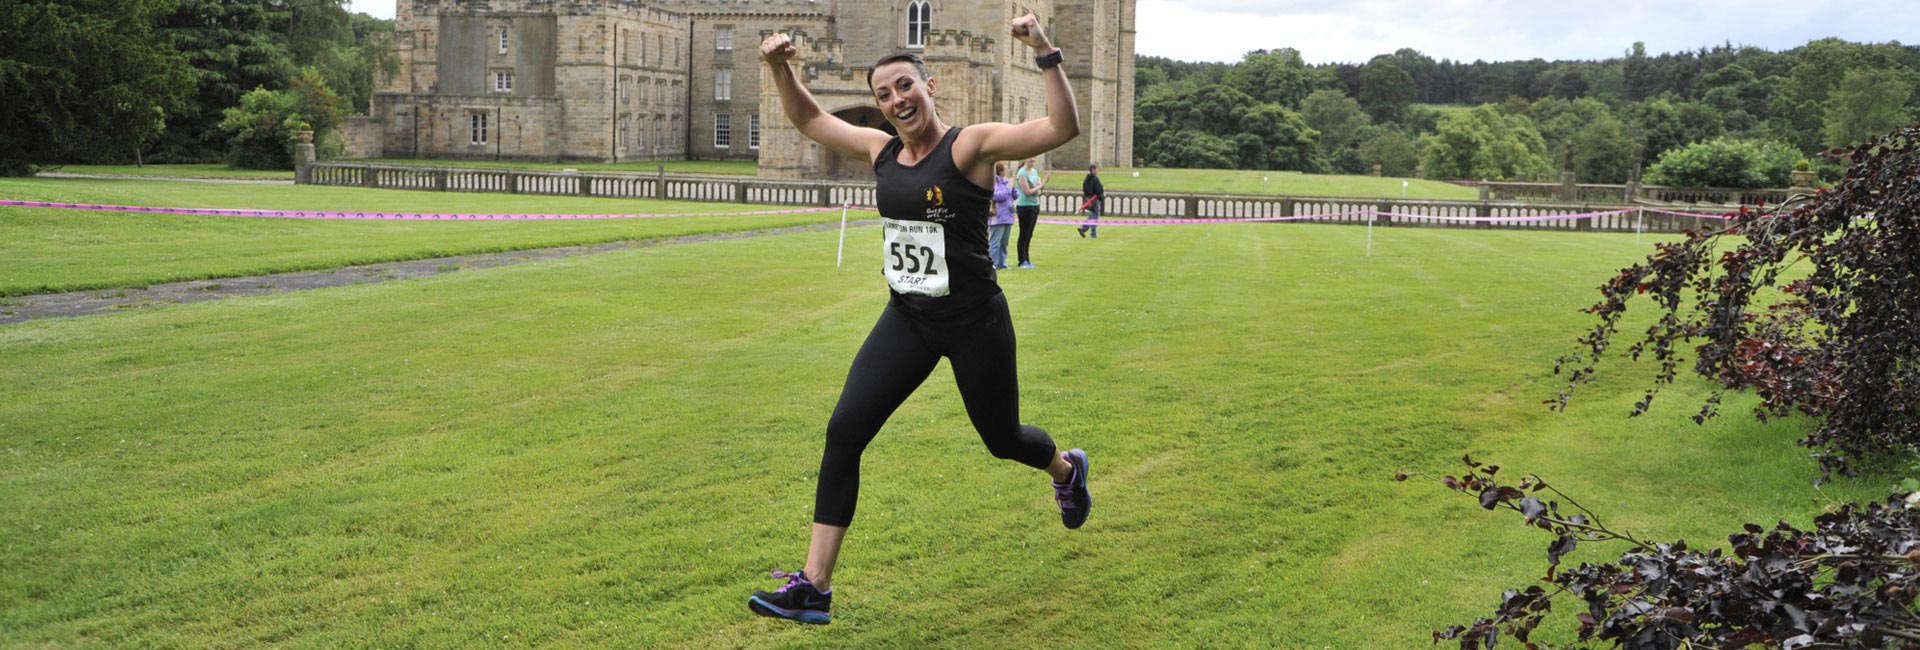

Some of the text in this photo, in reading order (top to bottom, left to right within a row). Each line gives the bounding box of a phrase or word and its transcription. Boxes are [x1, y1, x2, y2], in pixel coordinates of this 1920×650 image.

[909, 225, 924, 234] RUN
[925, 226, 938, 234] 10K
[890, 242, 938, 275] 552
[898, 275, 927, 285] START
